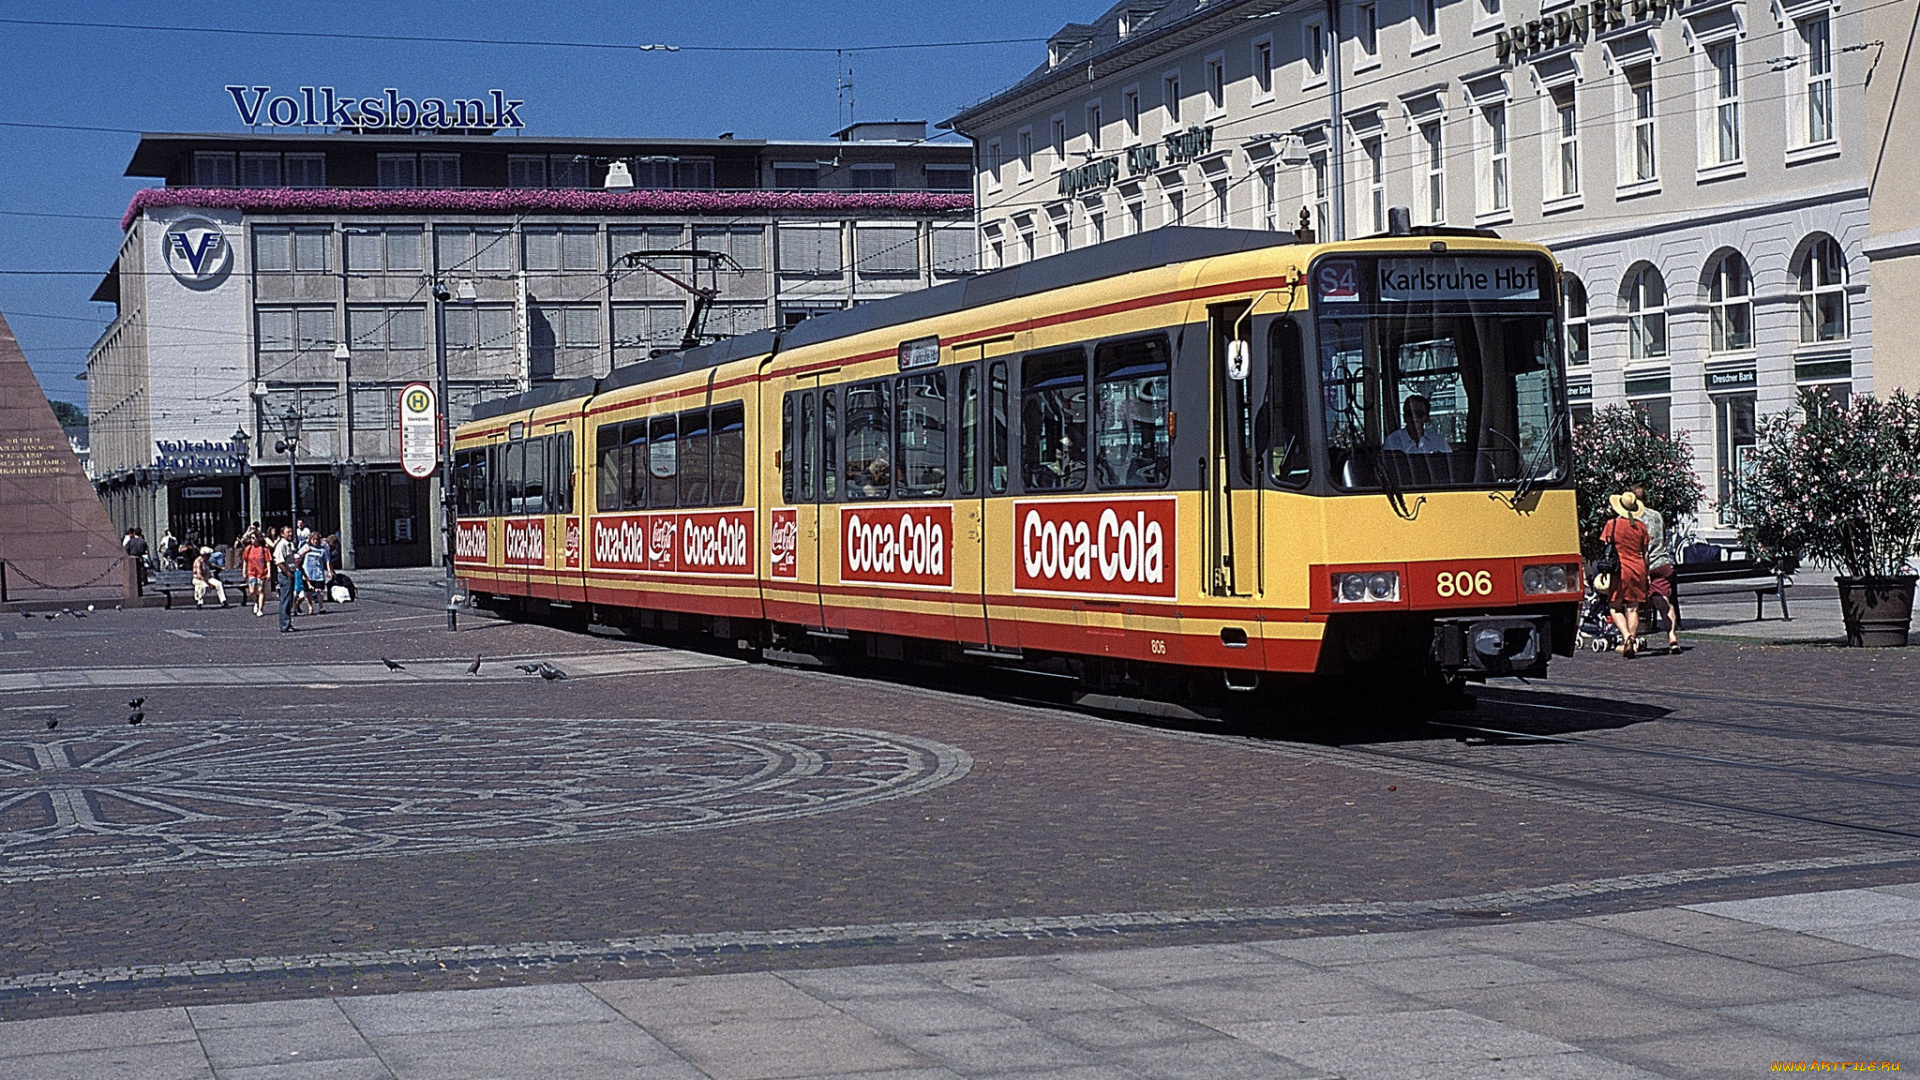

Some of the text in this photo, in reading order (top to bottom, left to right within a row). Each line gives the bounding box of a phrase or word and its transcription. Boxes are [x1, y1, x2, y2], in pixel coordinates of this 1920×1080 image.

[1494, 0, 1626, 59] DRESDNER
[226, 85, 525, 129] Volksbank
[1319, 266, 1536, 292] S4 Karlsruhe Hbf
[1578, 385, 1591, 395] Bank
[1712, 372, 1754, 384] Dresdner Bank
[155, 439, 236, 453] Volksban
[456, 523, 486, 557] Coca-Cola
[506, 523, 542, 559] Coca-Cola
[594, 520, 643, 563] Coca-Cola
[684, 516, 747, 566] Coca-Cola
[847, 513, 944, 576] Coca-Cola
[1023, 508, 1163, 584] Coca-Cola
[1436, 570, 1493, 597] 806
[1151, 639, 1166, 655] 806
